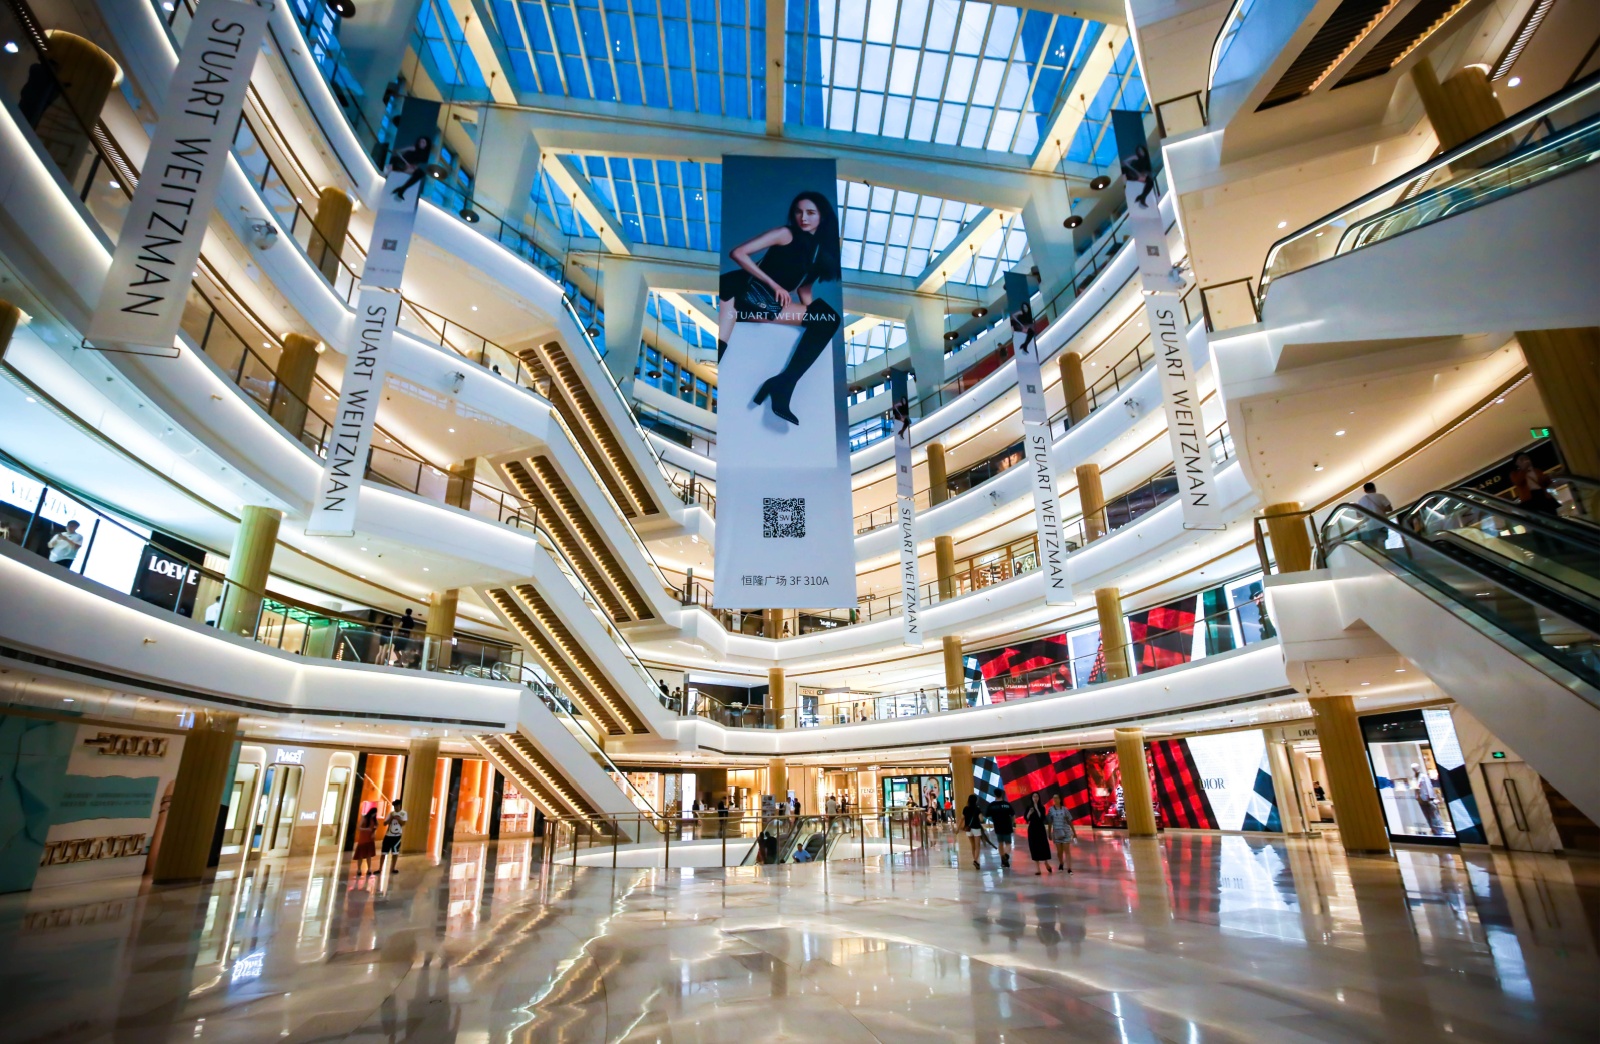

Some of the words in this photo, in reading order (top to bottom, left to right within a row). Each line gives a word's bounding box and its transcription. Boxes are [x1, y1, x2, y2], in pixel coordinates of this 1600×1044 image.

[184, 18, 245, 126] STUART
[120, 138, 212, 317] WEITZMAN
[353, 304, 387, 381] STUART
[727, 311, 769, 320] STUART
[774, 312, 836, 322] WEITZMAN
[1156, 309, 1186, 381] STUART
[1172, 389, 1209, 508] WEITZMAN
[322, 388, 370, 513] WEITZMAN
[1032, 435, 1052, 493] STUART
[901, 507, 913, 555] STUART
[1040, 499, 1065, 590] WEITZMAN
[148, 555, 199, 585] LOEWE
[741, 575, 787, 586] 恒隆广场
[790, 576, 801, 586] 3F
[804, 576, 829, 586] 310A
[904, 560, 918, 635] WEITZMAN
[1200, 778, 1226, 790] DIOR
